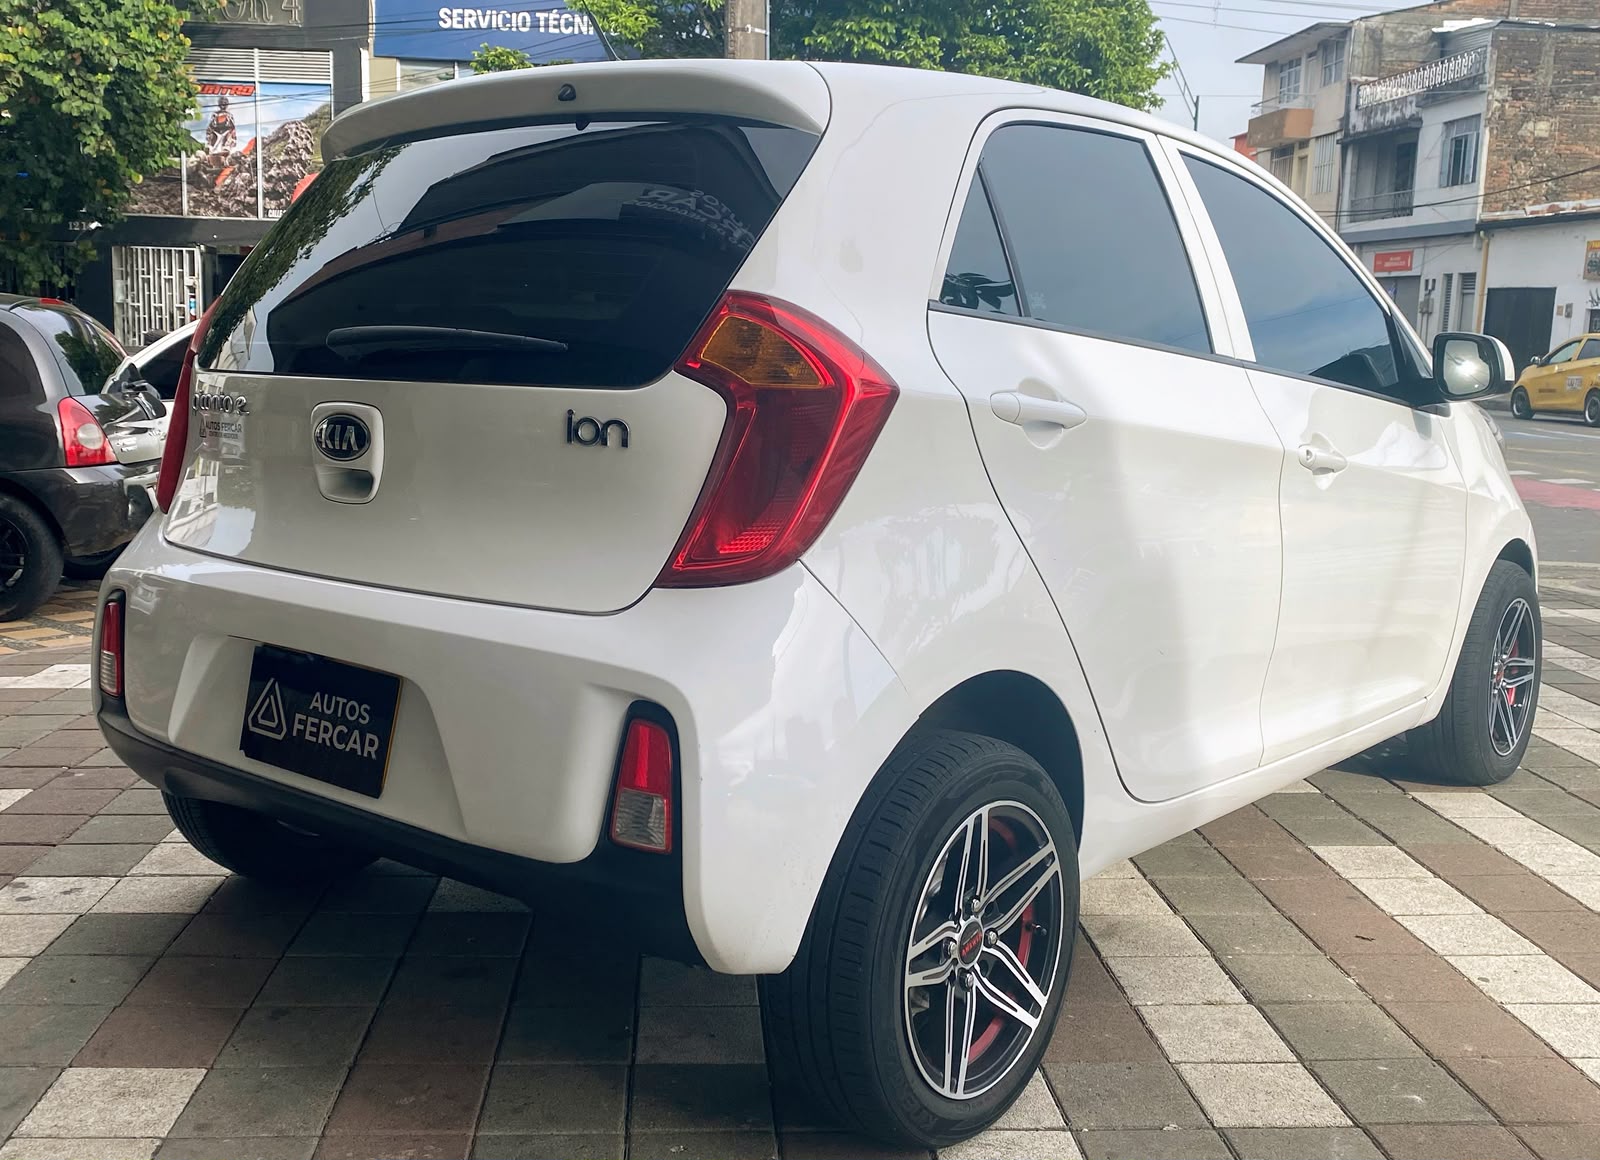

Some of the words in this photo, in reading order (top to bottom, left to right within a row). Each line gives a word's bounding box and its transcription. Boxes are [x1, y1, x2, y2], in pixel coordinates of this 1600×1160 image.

[438, 7, 532, 32] SERVICIO
[320, 422, 360, 451] KIA
[566, 408, 630, 448] ion
[309, 691, 371, 725] AUTOS
[292, 712, 380, 761] FERCAR
